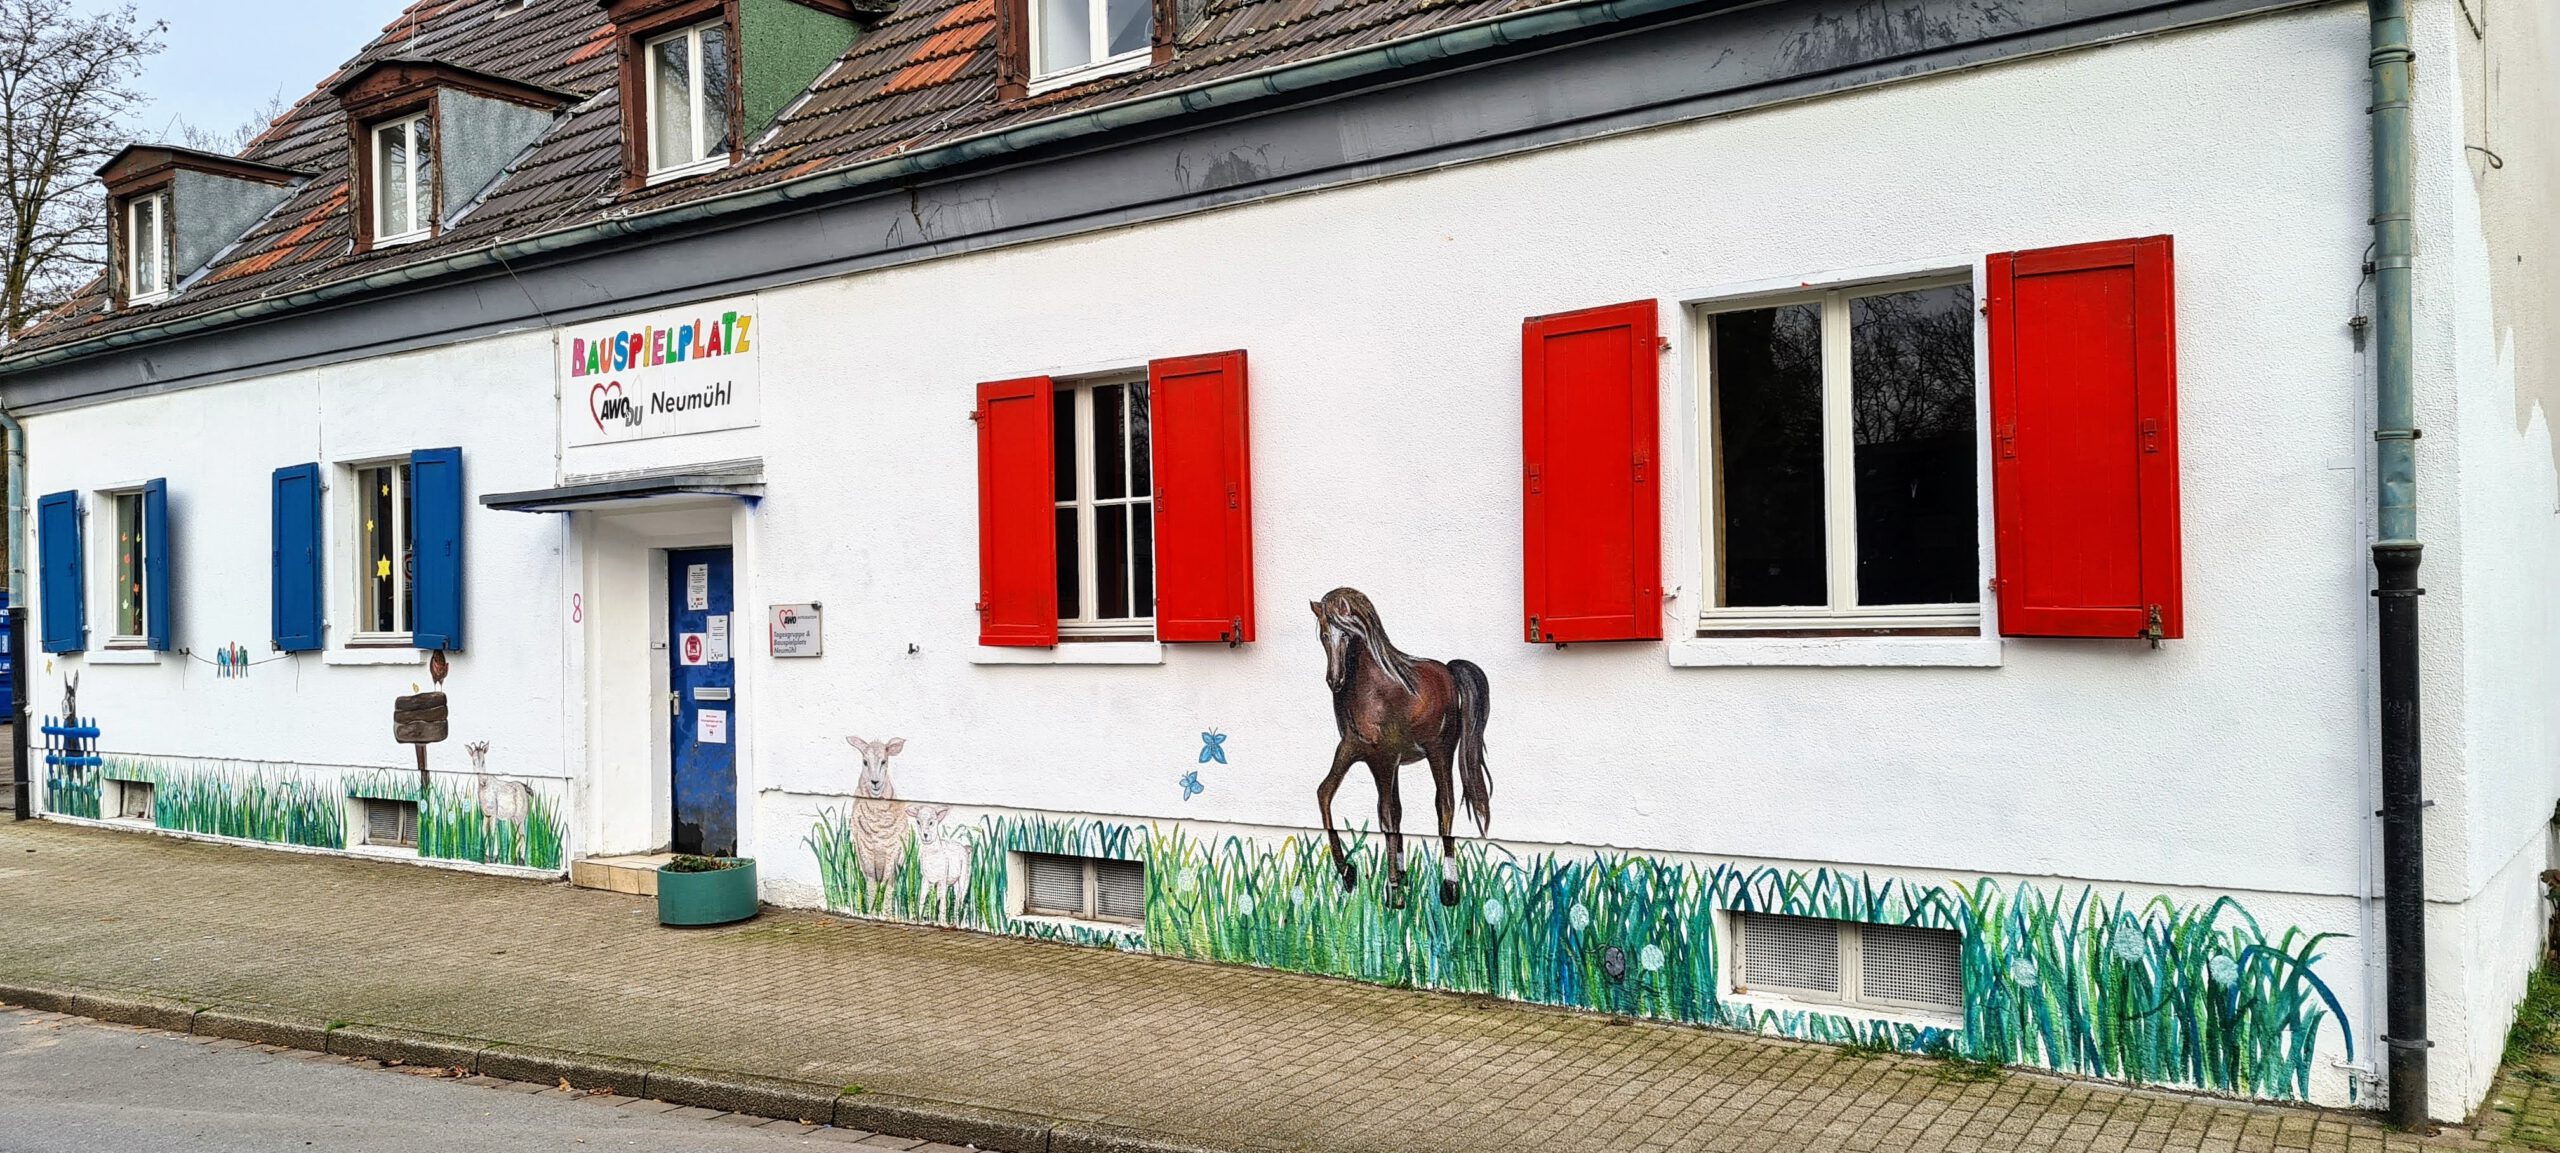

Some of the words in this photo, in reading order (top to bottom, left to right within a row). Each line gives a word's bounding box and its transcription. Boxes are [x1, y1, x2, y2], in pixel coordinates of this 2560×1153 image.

[571, 310, 752, 378] BAUSPIELPLATZ
[600, 396, 631, 421] AWO
[625, 404, 644, 428] DU
[650, 380, 732, 415] Neumühl
[572, 592, 582, 624] 8
[784, 616, 796, 624] AWO
